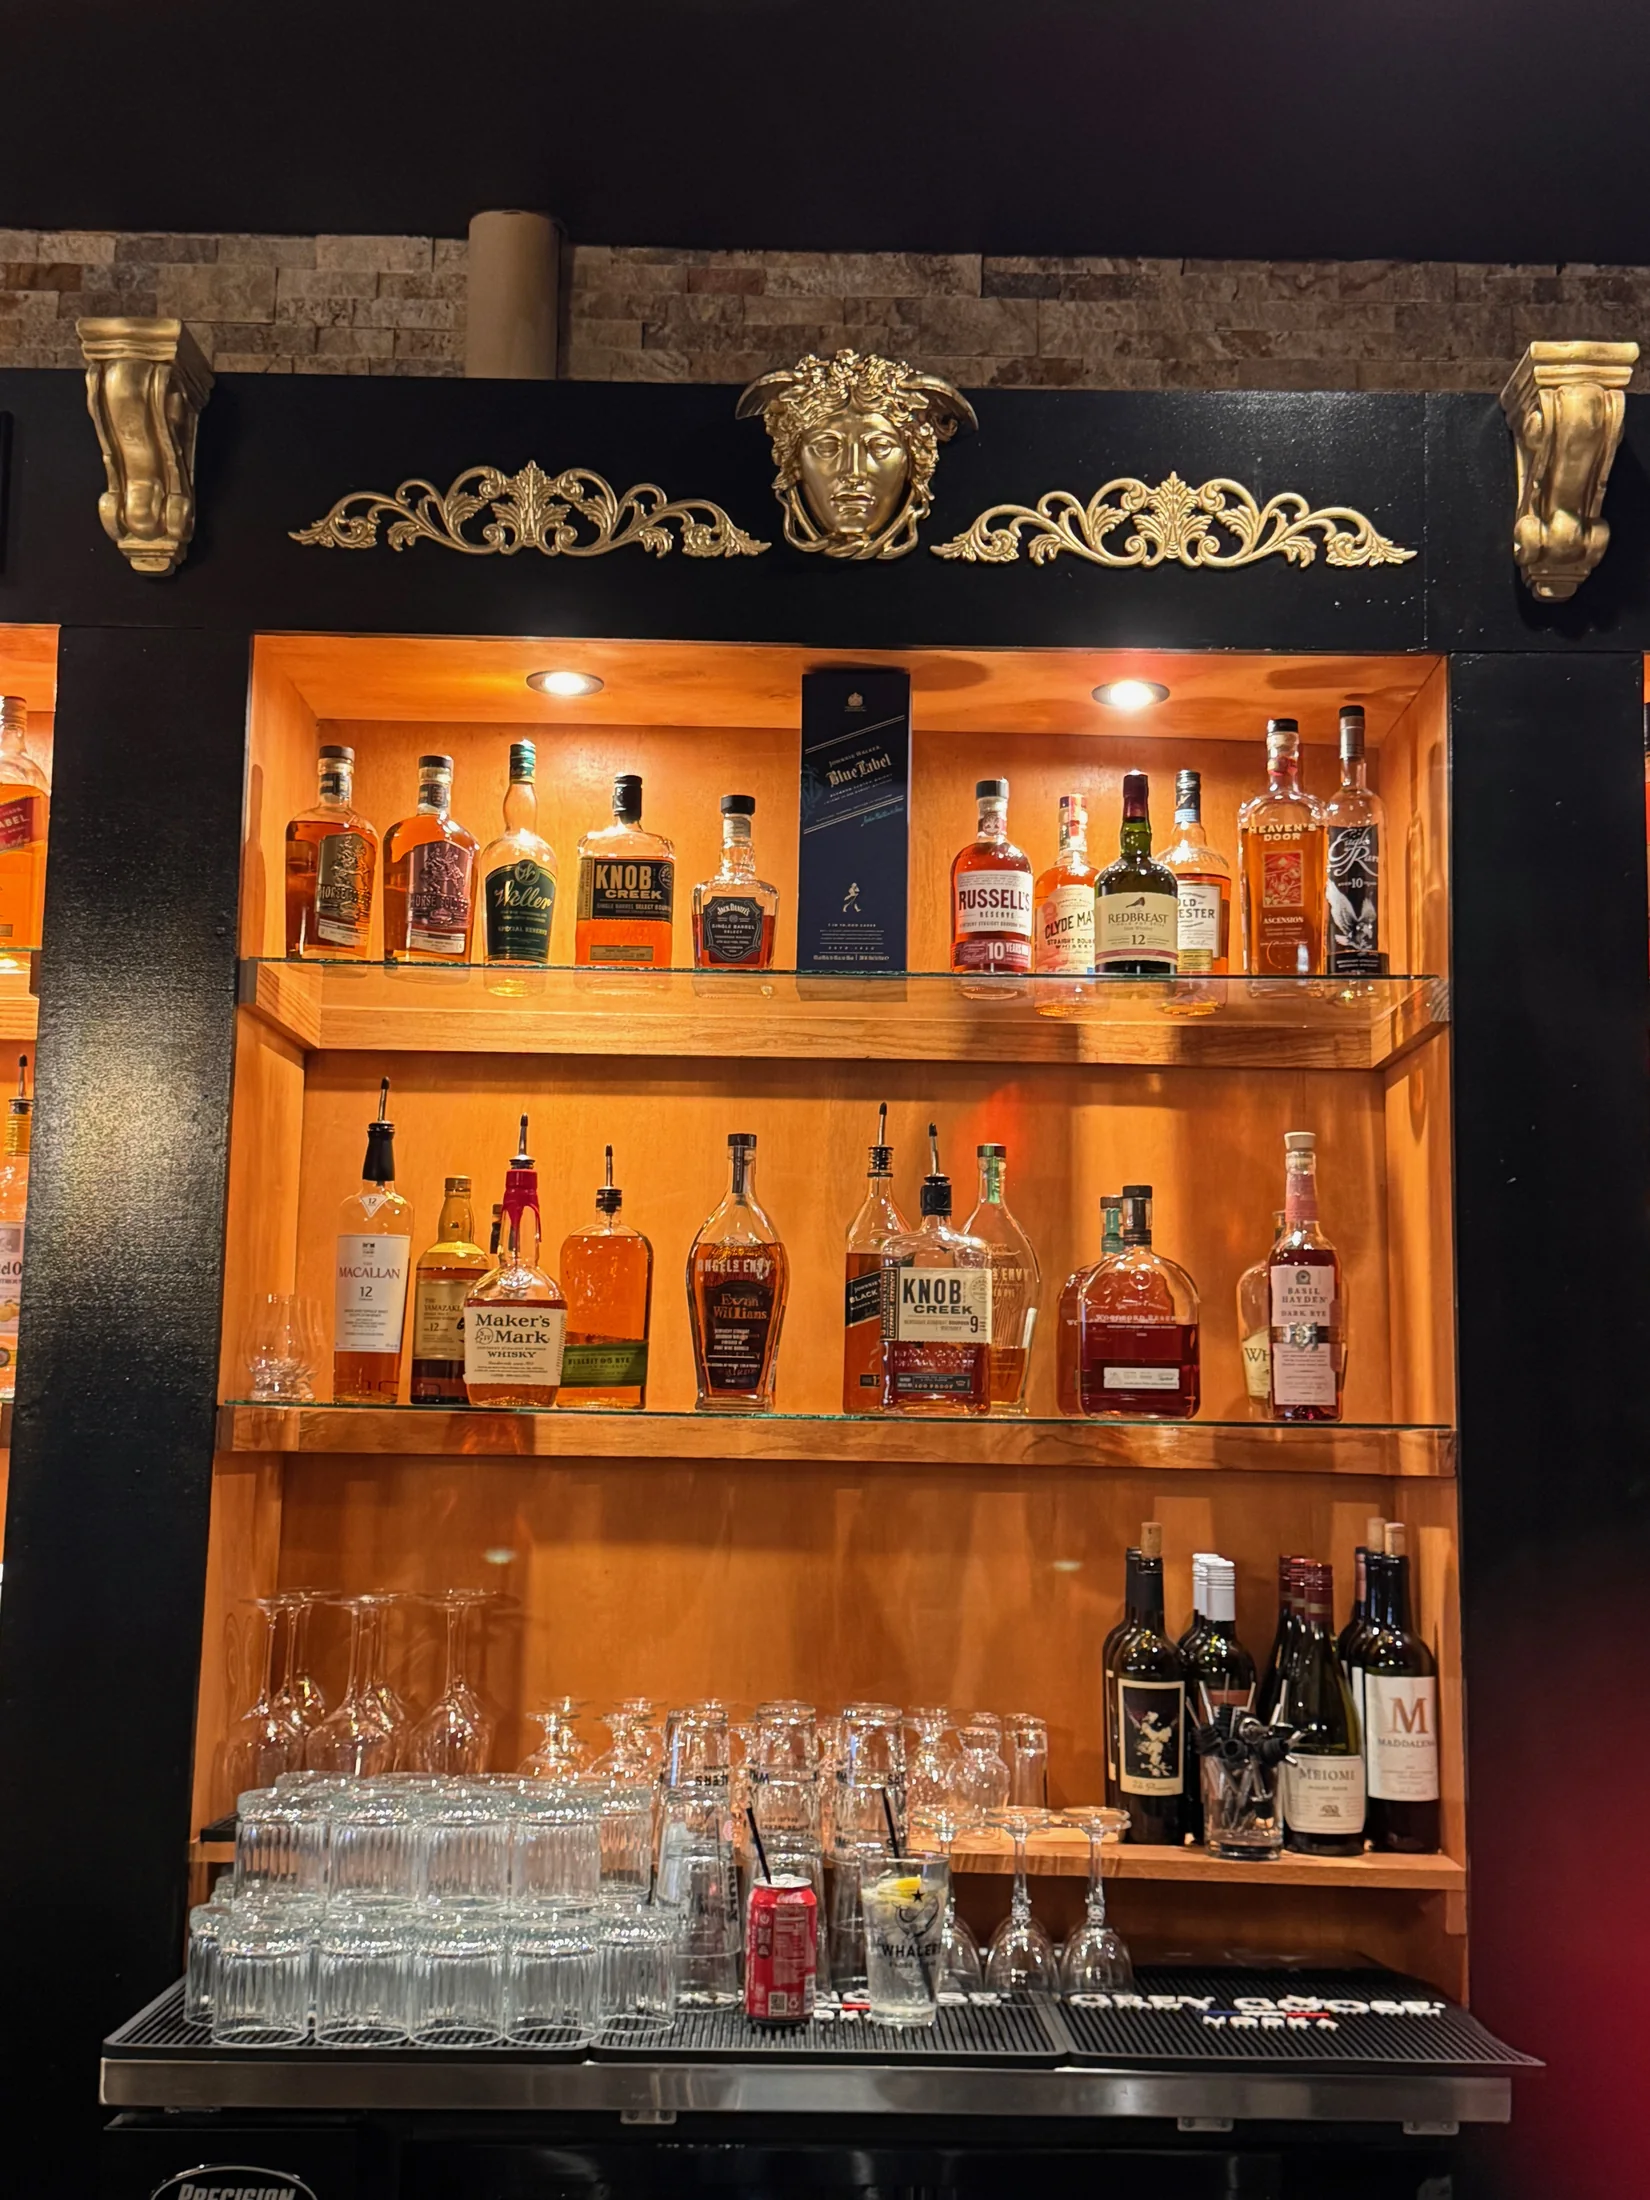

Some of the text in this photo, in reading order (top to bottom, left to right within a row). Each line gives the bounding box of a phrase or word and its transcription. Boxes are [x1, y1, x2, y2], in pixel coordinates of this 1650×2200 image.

[825, 753, 893, 788] Blue Label
[0, 815, 30, 828] ABEL
[1248, 823, 1317, 834] HEAVEN'S
[1263, 833, 1301, 842] DOOR
[595, 864, 652, 890] KNOB
[1351, 877, 1364, 889] 10
[494, 879, 552, 910] Weller
[605, 889, 663, 900] CREEK
[958, 888, 1030, 912] RUSSELL'S
[1107, 912, 1170, 925] REDBREAST
[1178, 908, 1216, 919] ESTER
[1044, 909, 1094, 940] CLYDE MA
[1263, 916, 1304, 925] ASCENSION
[1131, 934, 1146, 946] 12
[987, 942, 1005, 960] 10
[368, 1197, 377, 1205] 12
[339, 1266, 401, 1279] MACALLAN
[359, 1286, 373, 1298] 12
[849, 1289, 878, 1303] LACK
[903, 1278, 962, 1305] KNOB
[1287, 1287, 1320, 1295] BASIL
[1282, 1295, 1328, 1304] HAYDEN
[913, 1305, 973, 1315] CREEK
[430, 1322, 440, 1332] 12
[474, 1313, 551, 1328] Maker's
[970, 1315, 979, 1334] 9
[493, 1330, 550, 1344] Mark
[487, 1350, 537, 1358] WHISKY
[1388, 1696, 1430, 1735] M
[1299, 1766, 1356, 1781] MEIOMI
